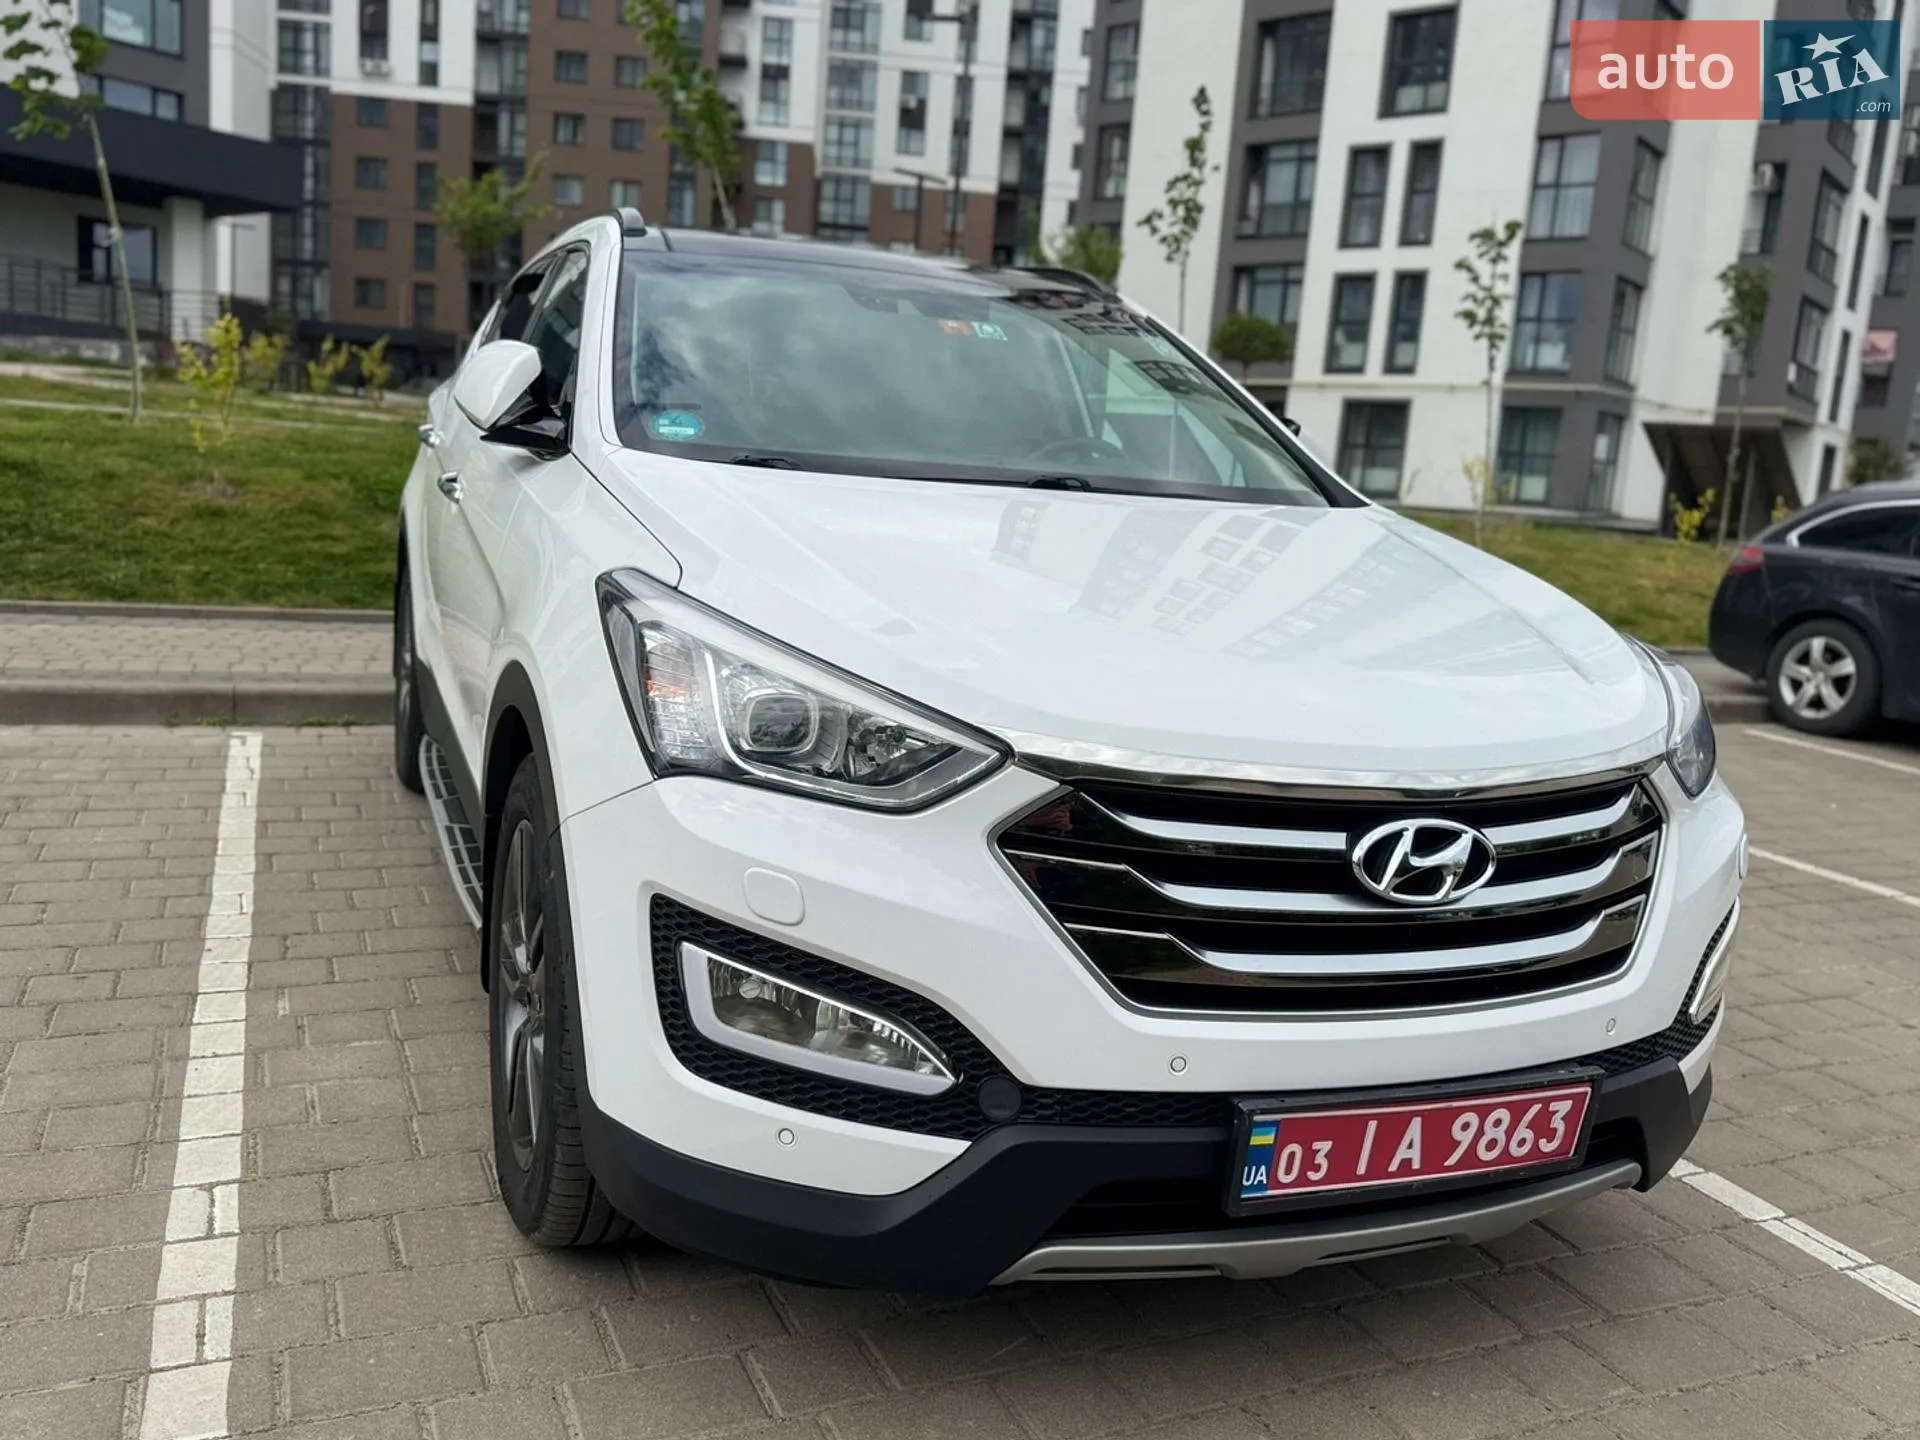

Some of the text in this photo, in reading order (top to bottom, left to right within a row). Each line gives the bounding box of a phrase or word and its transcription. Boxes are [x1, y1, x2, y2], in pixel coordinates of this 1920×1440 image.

[1276, 1141, 1333, 1184] 03
[1444, 1100, 1573, 1166] 9863
[1242, 1165, 1267, 1186] UA
